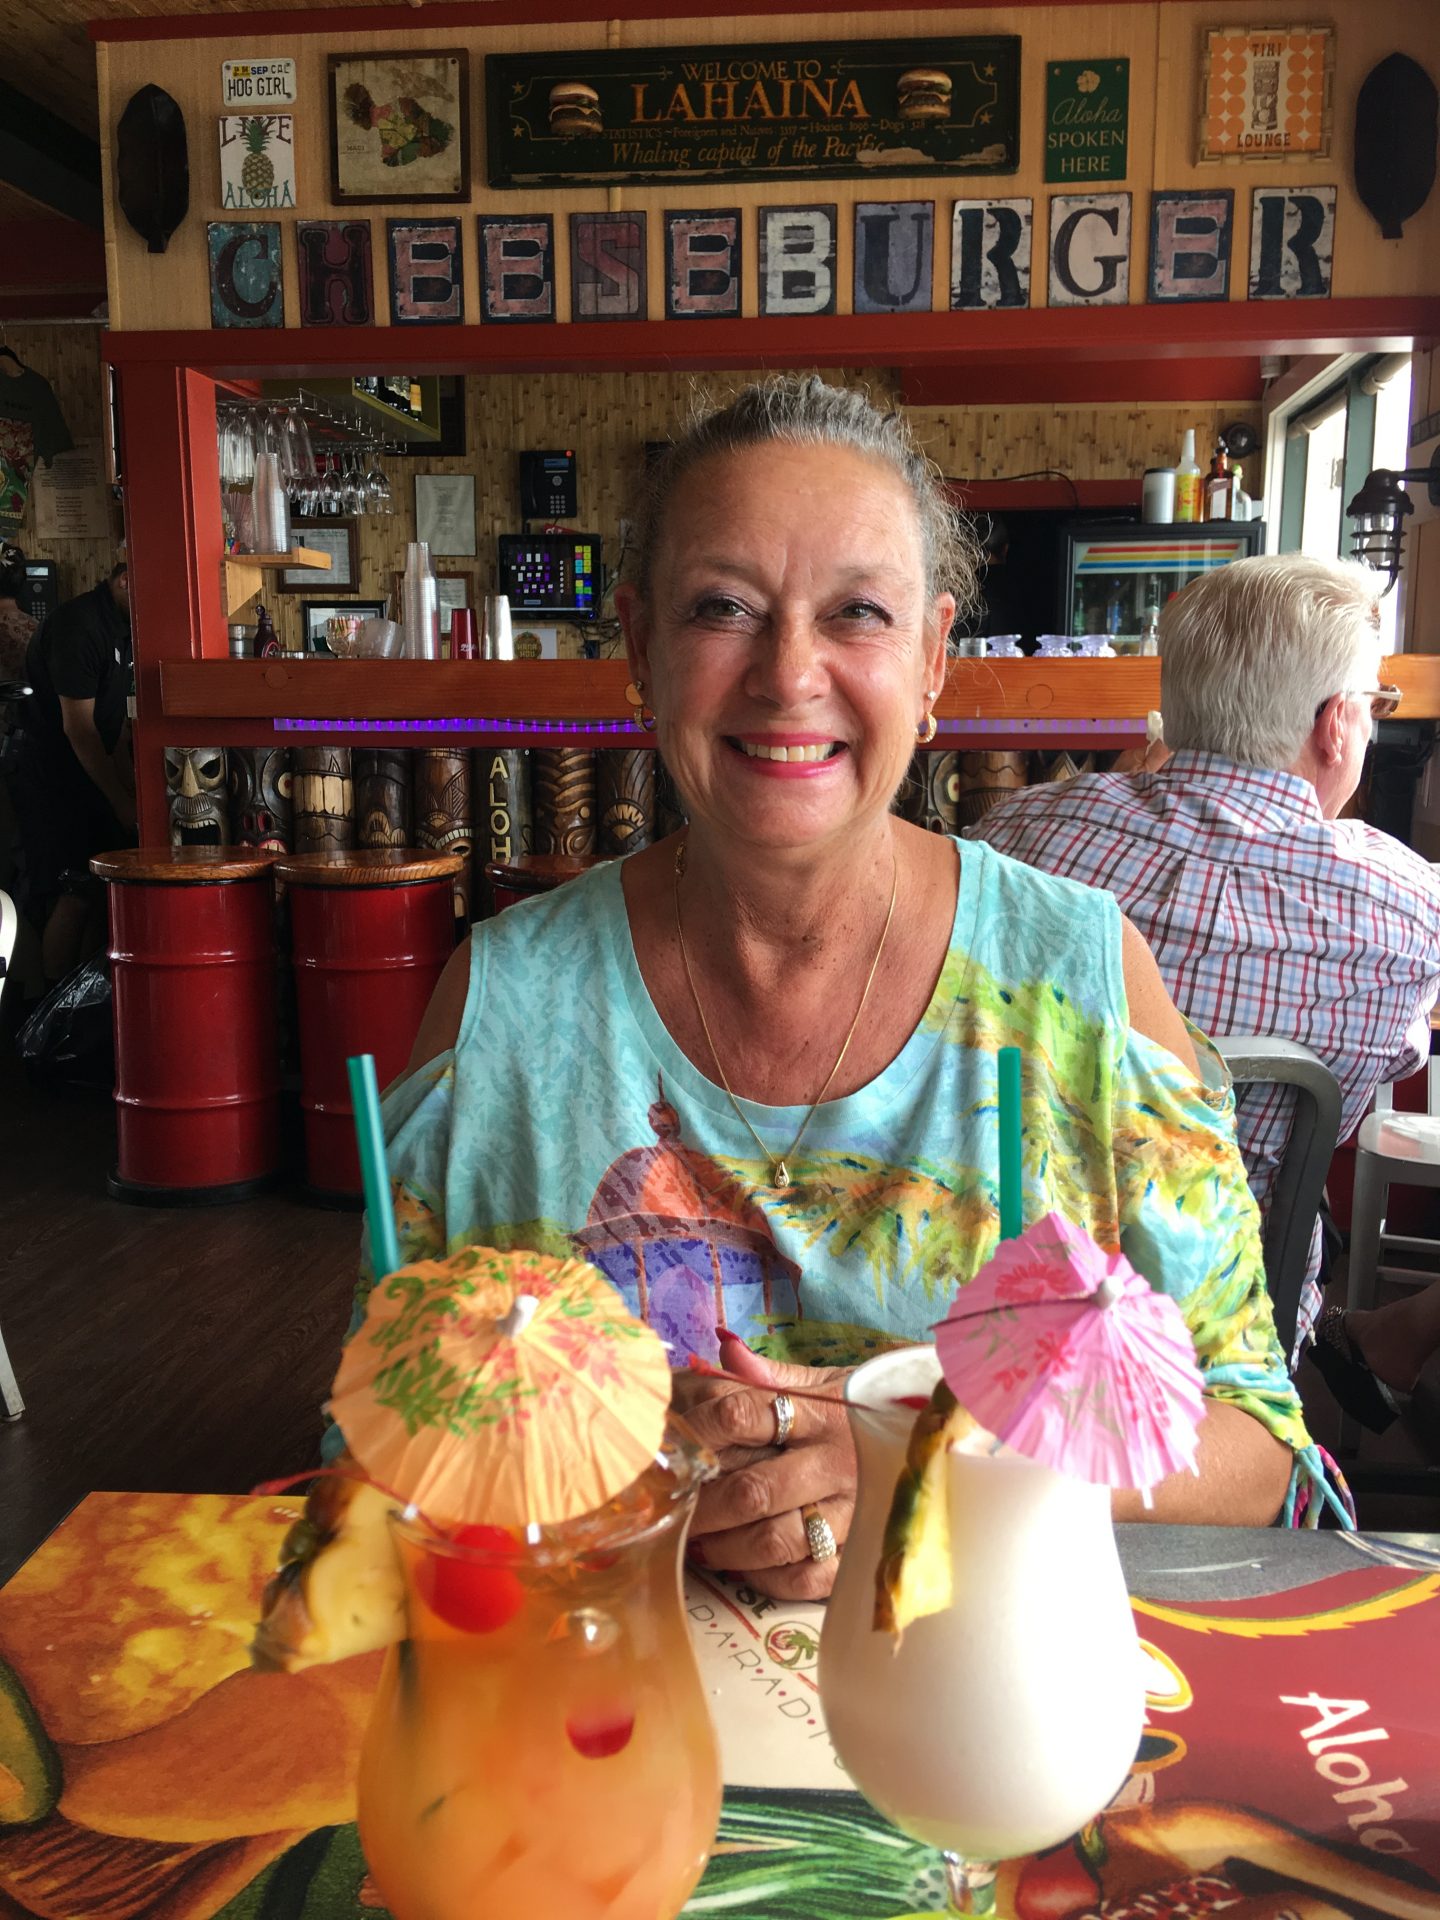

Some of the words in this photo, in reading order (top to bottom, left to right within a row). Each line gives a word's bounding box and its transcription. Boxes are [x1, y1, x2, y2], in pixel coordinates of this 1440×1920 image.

[1252, 43, 1282, 57] TIKI
[250, 66, 268, 75] SEP
[271, 64, 289, 74] CAL
[681, 60, 788, 81] WELCOME
[794, 59, 822, 79] TO
[228, 79, 253, 97] HOG
[257, 77, 289, 96] GIRL
[630, 78, 871, 123] LAHAINA
[1051, 97, 1123, 126] Aloha
[219, 115, 291, 148] LIVE
[720, 125, 737, 137] and
[1048, 130, 1126, 150] SPOKEN
[1236, 132, 1292, 148] LOUNGE
[612, 142, 691, 168] Whaling
[697, 137, 757, 168] capital
[767, 136, 789, 166] of
[792, 136, 818, 159] the
[1060, 155, 1111, 174] HERE
[223, 180, 295, 208] ALOHA
[216, 195, 1327, 323] CHEESEBURGER
[489, 756, 512, 864] ALOH
[1278, 1691, 1420, 1854] Aloha
